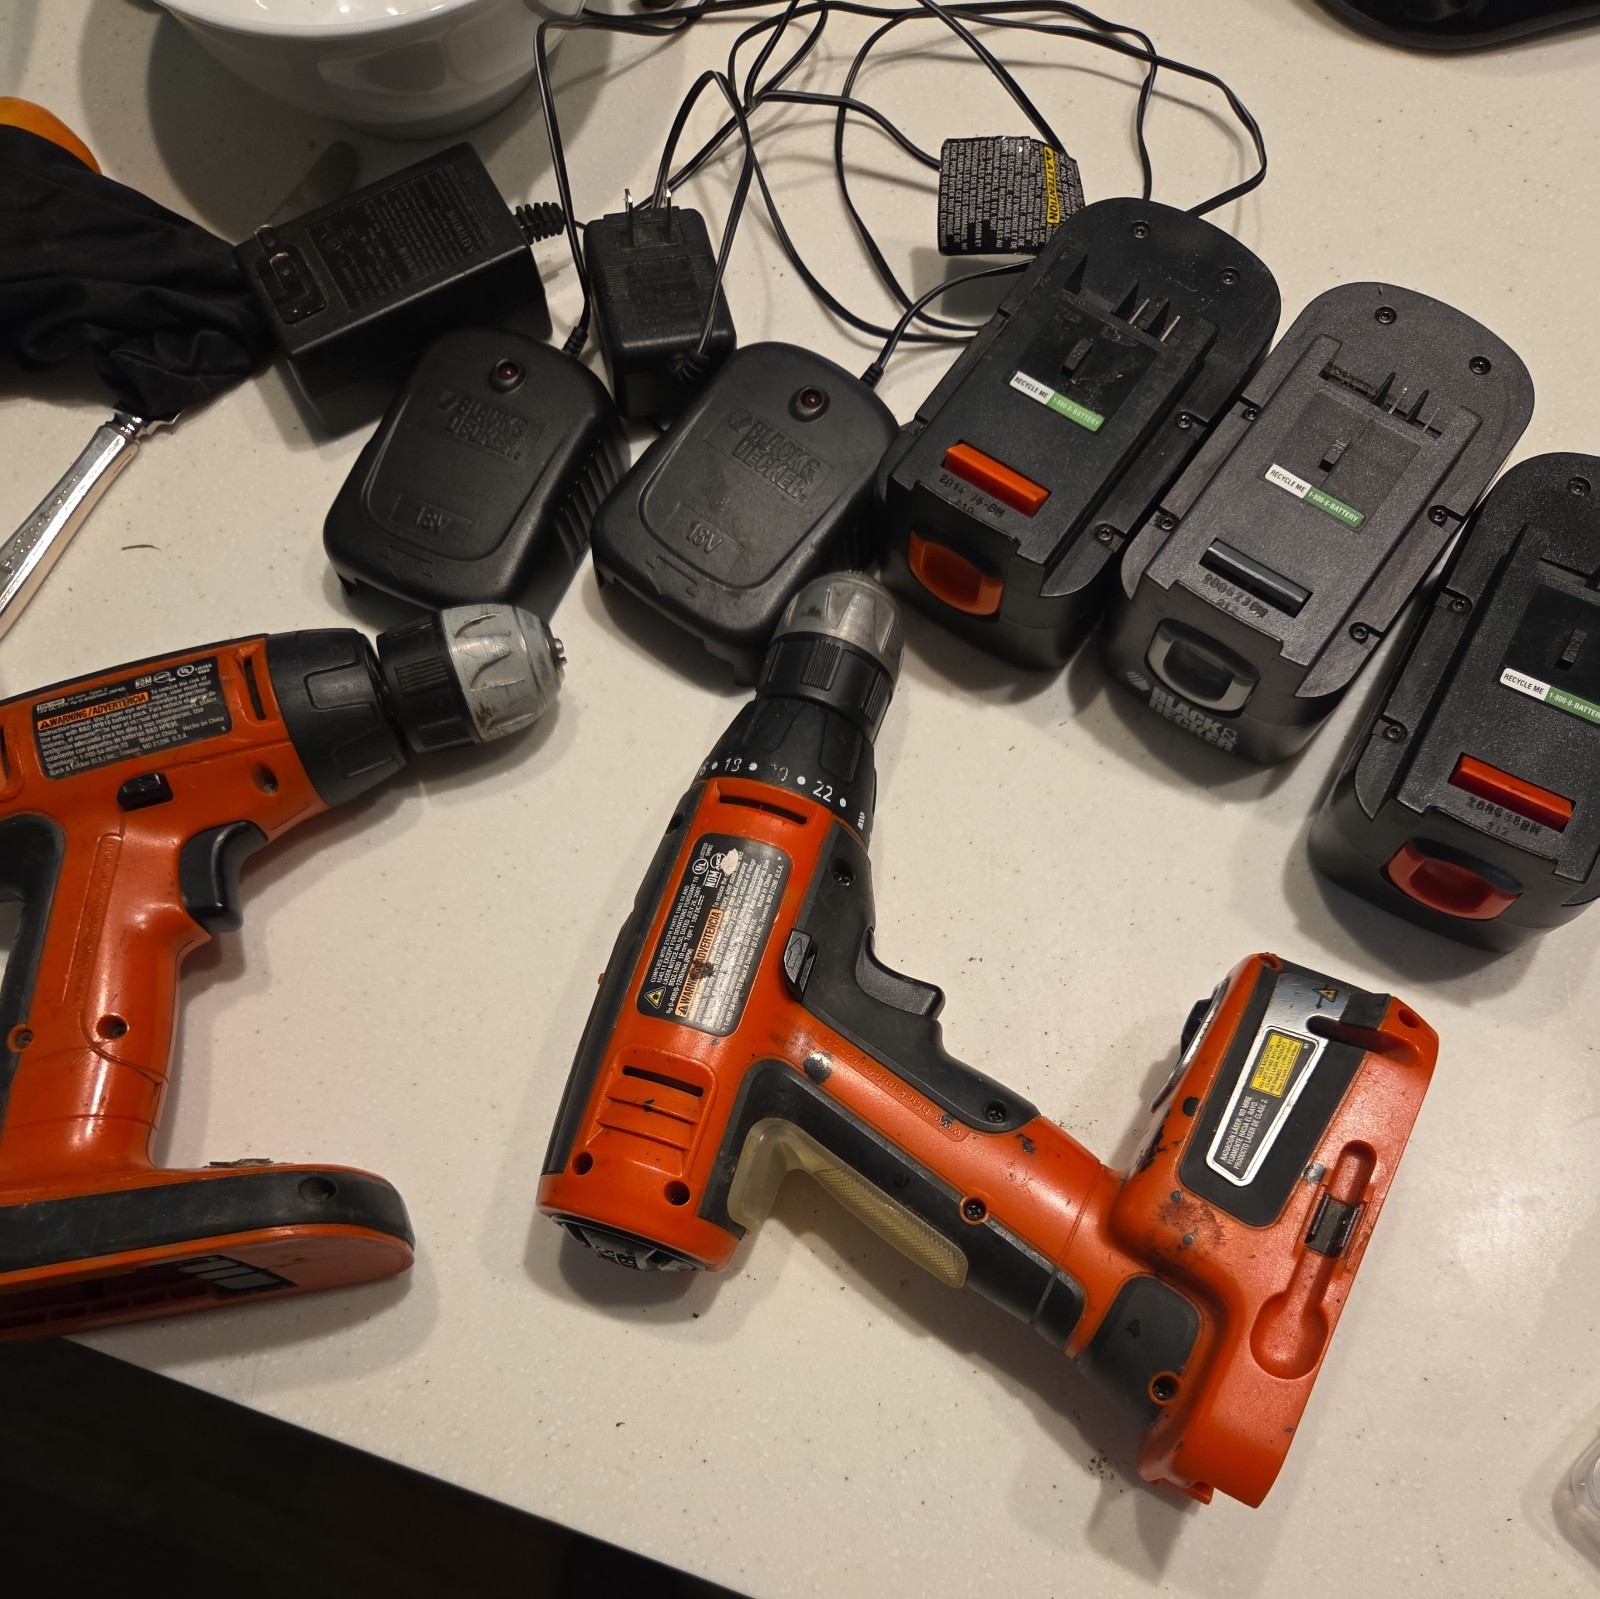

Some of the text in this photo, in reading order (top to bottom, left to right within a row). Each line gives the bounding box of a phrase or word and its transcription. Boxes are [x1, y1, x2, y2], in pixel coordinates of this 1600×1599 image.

[978, 140, 986, 177] BLOCS-PILES
[942, 176, 948, 184] OU
[963, 183, 969, 191] OU
[985, 175, 991, 183] DE
[976, 178, 984, 207] POURRAIT
[991, 191, 997, 199] DE
[1019, 178, 1027, 214] SEULEMENT.
[1027, 177, 1035, 212] UTILISATION
[1046, 162, 1057, 220] ATTENTION
[968, 189, 976, 223] BLESSURES
[983, 202, 989, 211] OU
[997, 188, 1005, 218] RECHARGE
[982, 212, 989, 220] DE
[1033, 220, 1038, 228] DE
[974, 239, 980, 247] ET
[995, 239, 1001, 247] AU
[1011, 232, 1017, 240] ET
[1018, 238, 1024, 246] DE
[1025, 231, 1031, 239] UN
[1010, 241, 1016, 249] DE
[1013, 375, 1048, 398] RECYCLE ME
[1051, 396, 1100, 427] 1-800-8-BATTERY
[731, 437, 808, 499] DECKER
[1269, 468, 1306, 493] RECYCLE ME
[1306, 490, 1359, 523] 1-800-8-BATTERY
[685, 520, 723, 555] 18V
[133, 675, 153, 687] NOM
[183, 683, 198, 691] must
[198, 679, 211, 687] read
[1502, 672, 1544, 694] RECYCLE ME
[1147, 698, 1234, 752] DECKER
[811, 778, 833, 802] 22
[704, 868, 719, 889] NOM
[1240, 1094, 1251, 1109] MIRE
[1246, 1099, 1258, 1115] RAYO.
[1237, 1107, 1246, 1117] NO
[1243, 1114, 1252, 1122] EL
[1253, 1102, 1265, 1119] CLASE
[1250, 1118, 1259, 1127] DE
[1232, 1142, 1249, 1170] PRODUCTO
